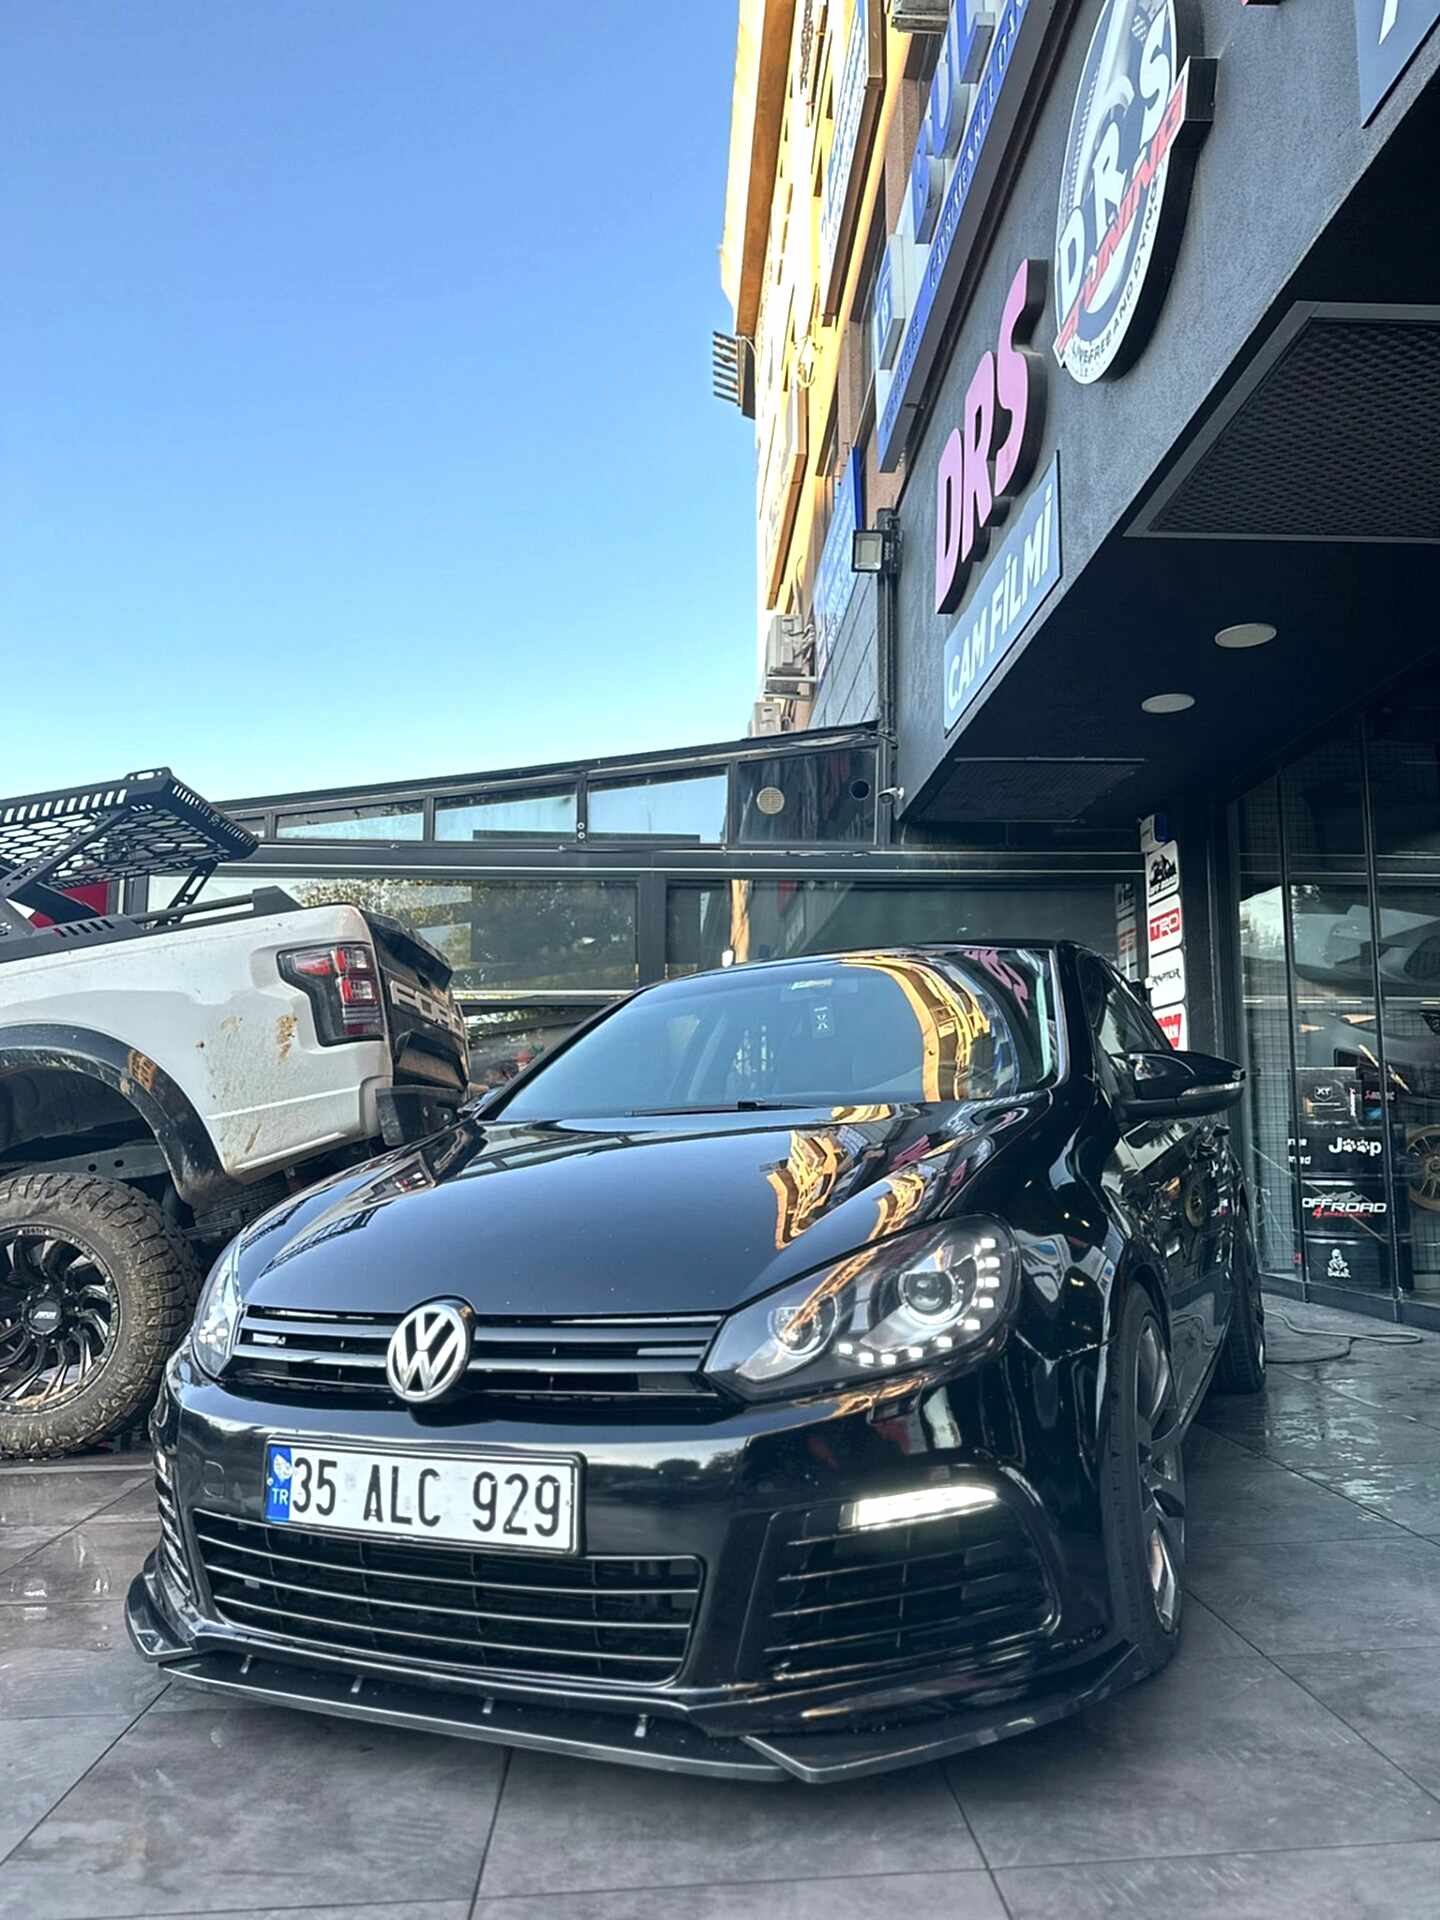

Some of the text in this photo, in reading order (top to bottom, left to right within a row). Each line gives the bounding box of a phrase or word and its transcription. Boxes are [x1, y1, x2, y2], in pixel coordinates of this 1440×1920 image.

[936, 258, 1029, 613] DRS
[948, 489, 1055, 709] CAM FİLMİ
[389, 980, 464, 1039] FORD
[271, 1457, 561, 1538] TR 35 ALC 929
